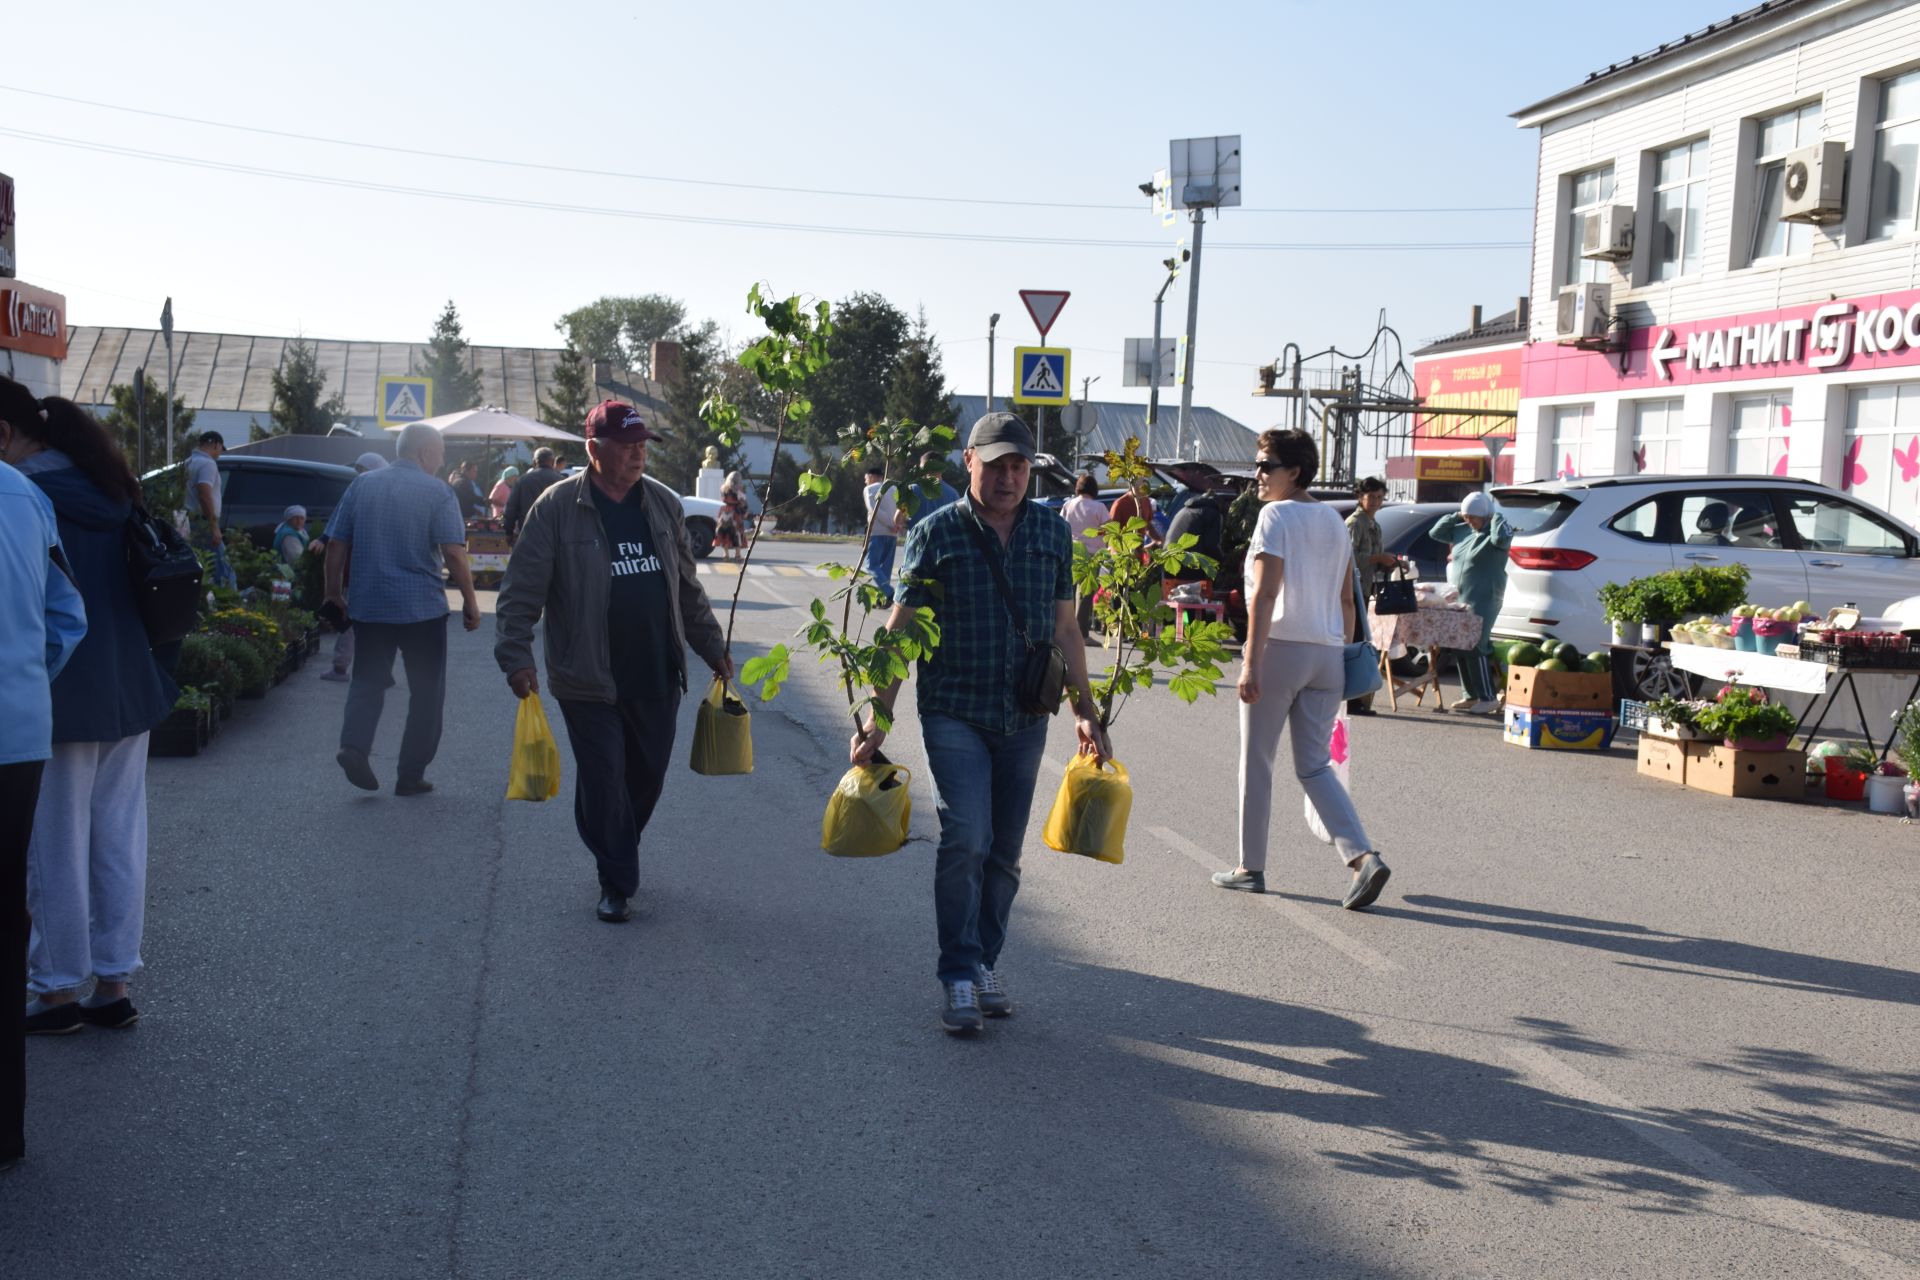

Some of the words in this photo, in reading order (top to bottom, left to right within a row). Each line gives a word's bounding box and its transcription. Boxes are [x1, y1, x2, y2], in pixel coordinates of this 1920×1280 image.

[22, 303, 58, 337] АПТЕКА
[1686, 318, 1808, 370] МАГНИТ
[1854, 302, 1920, 353] КОС
[617, 541, 643, 556] Fly
